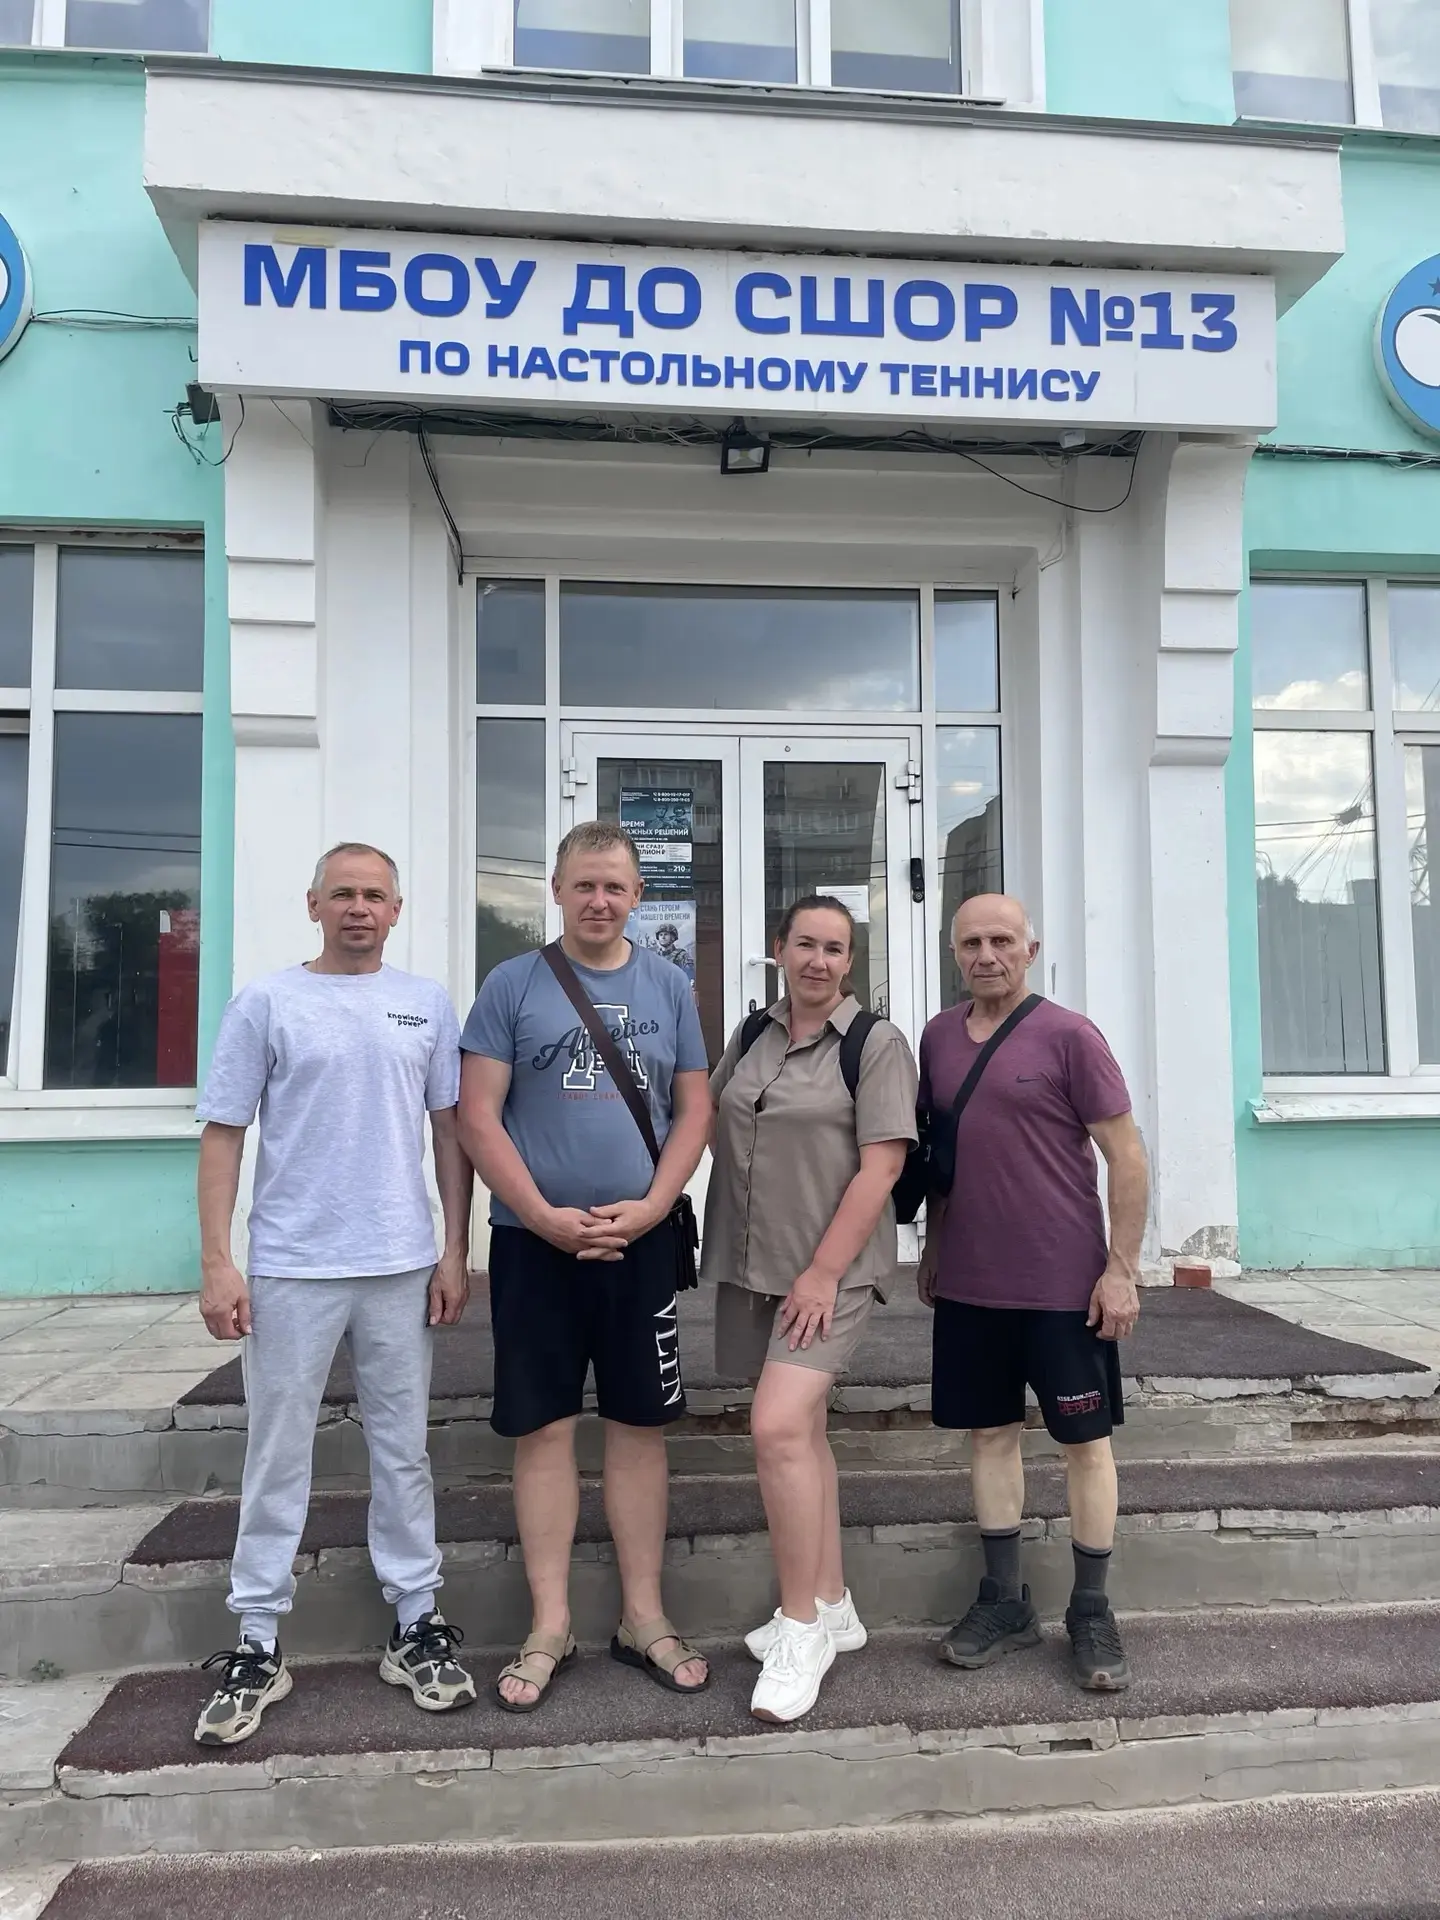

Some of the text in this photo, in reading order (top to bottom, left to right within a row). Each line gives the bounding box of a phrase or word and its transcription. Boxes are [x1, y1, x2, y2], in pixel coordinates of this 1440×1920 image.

[244, 244, 1238, 351] МБОУ ДО СШОР №13
[400, 340, 1101, 402] ПО НАСТОЛЬНОМУ ТЕННИСУ
[621, 820, 645, 828] ВРЕМЯ
[623, 828, 689, 836] АЖНЫХ РЕШЕНИЙ
[673, 865, 686, 873] 210
[640, 903, 680, 912] СТАНЬ ГЕРОЕМ
[640, 912, 691, 921] НАШЕГО ВРЕМЕНИ
[387, 1011, 428, 1025] knowledge
[653, 1293, 682, 1406] VLTN
